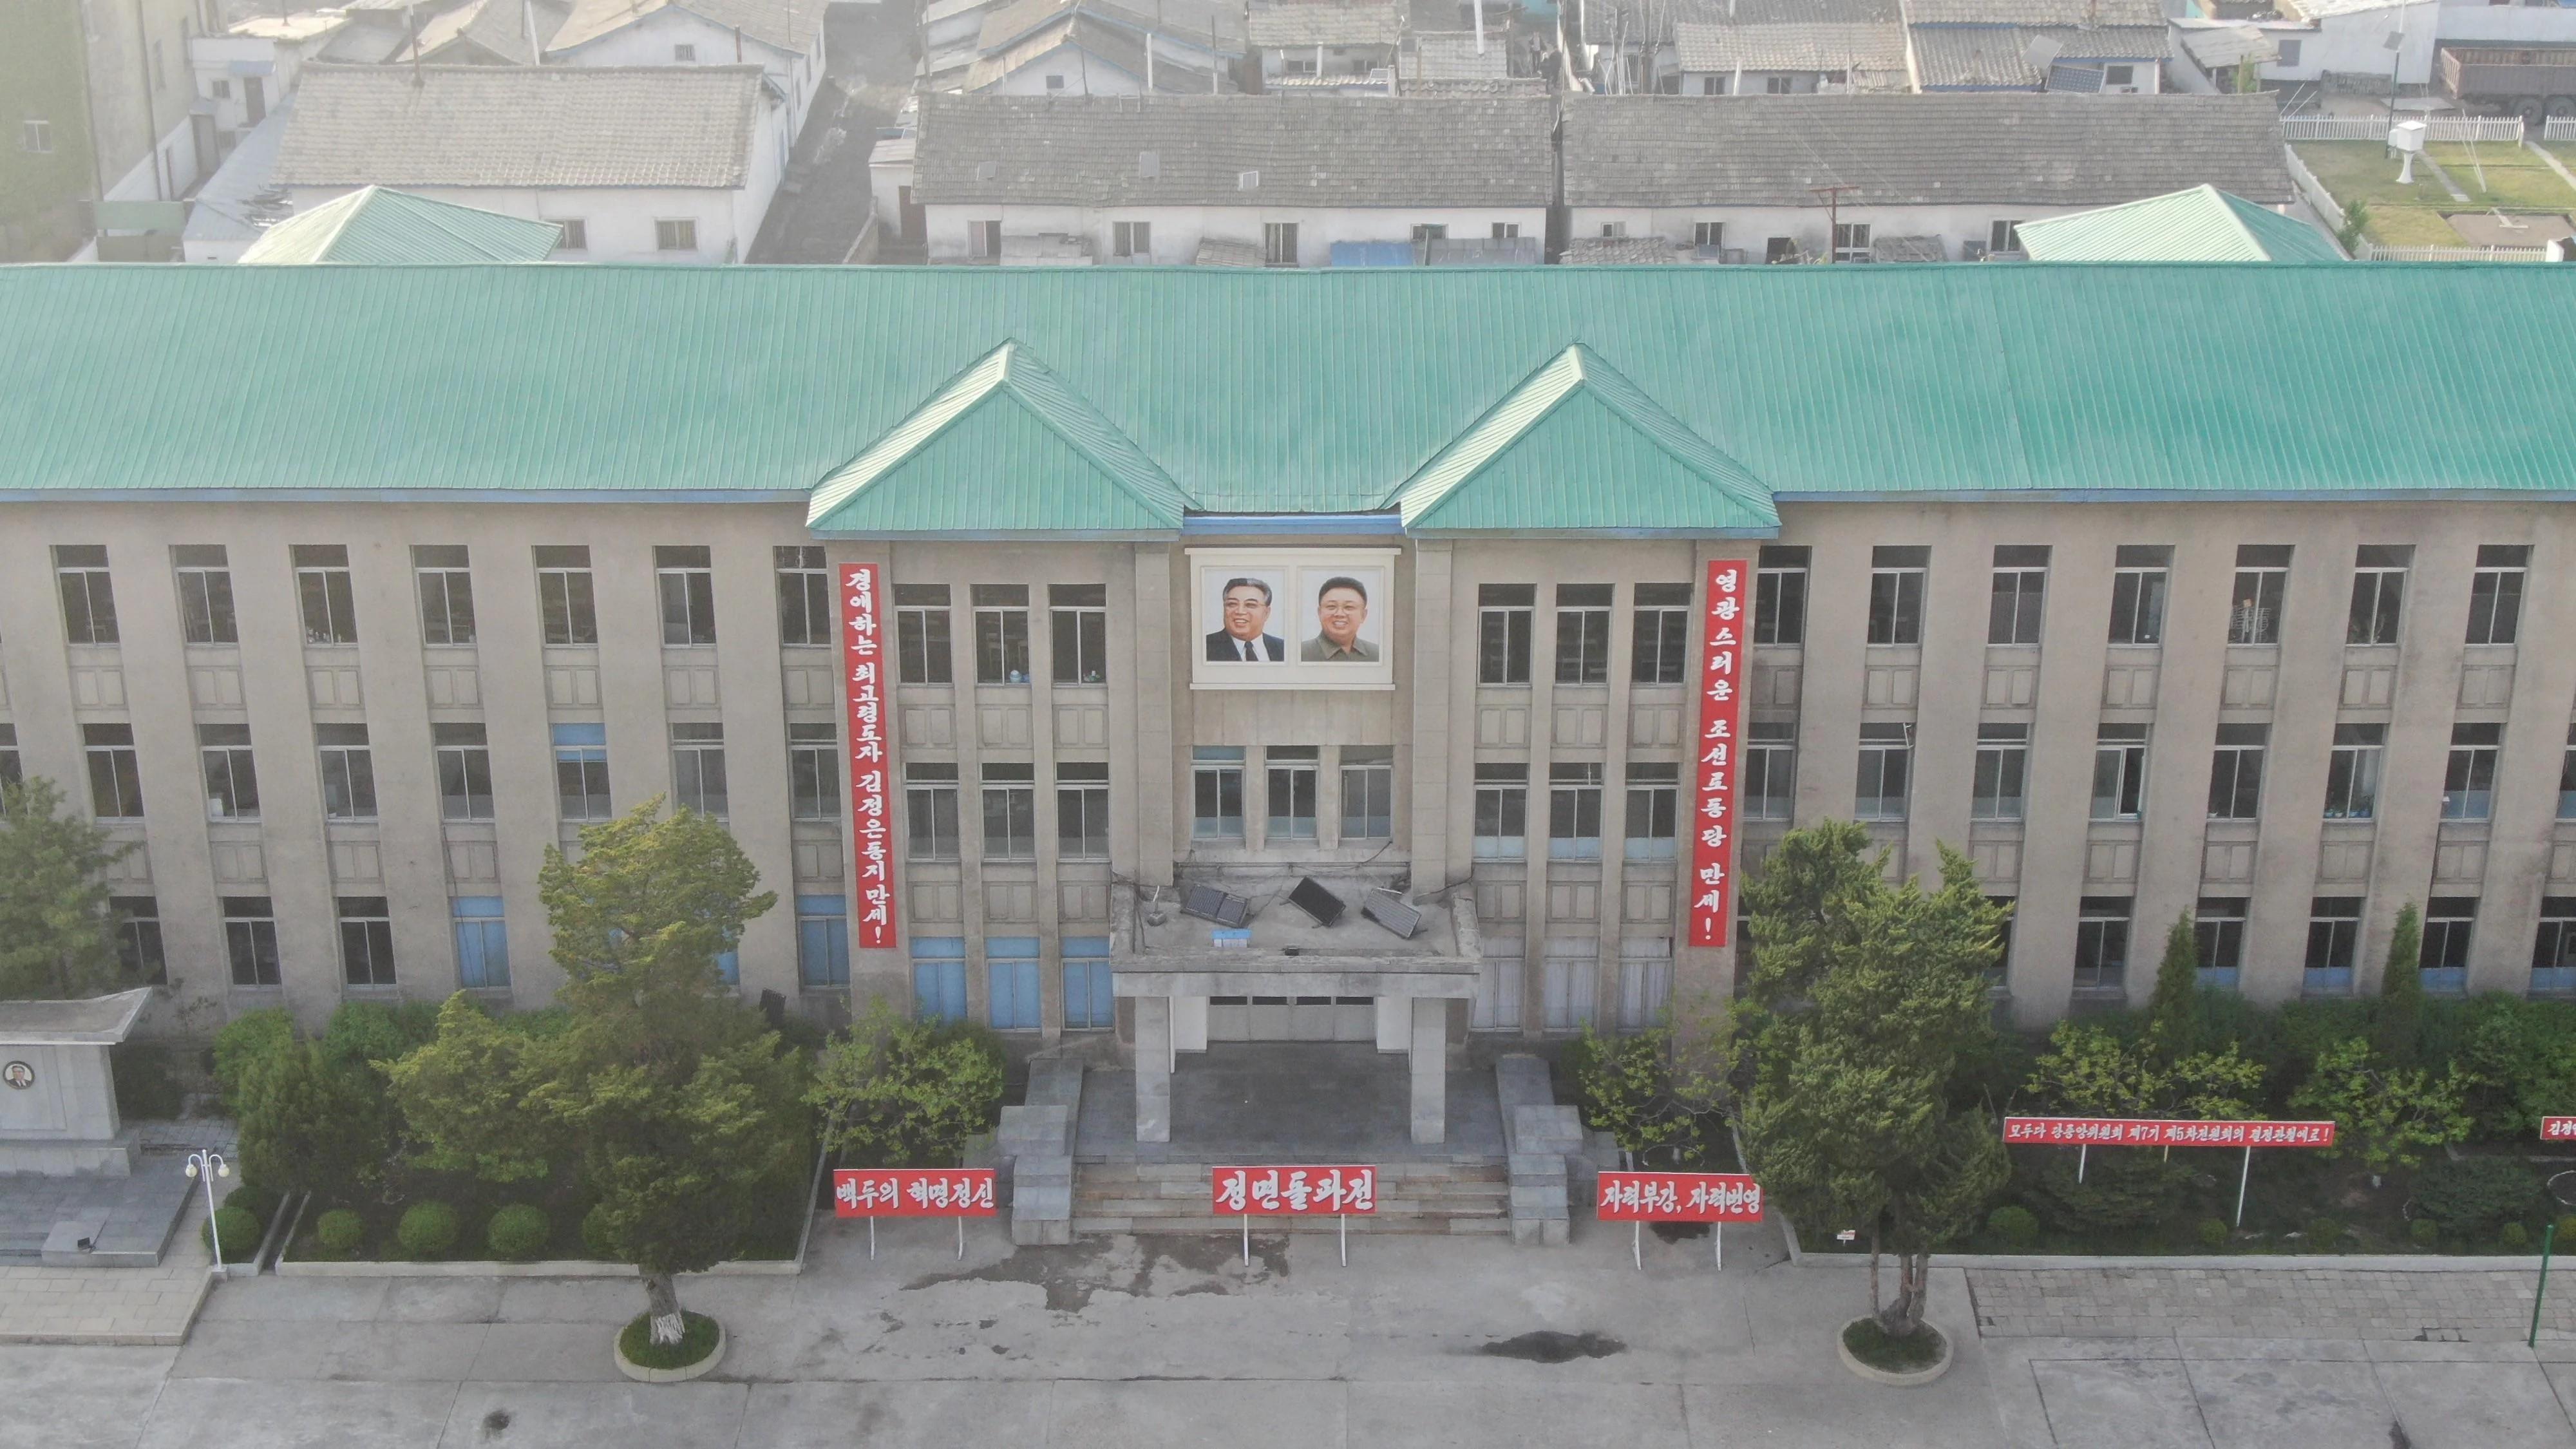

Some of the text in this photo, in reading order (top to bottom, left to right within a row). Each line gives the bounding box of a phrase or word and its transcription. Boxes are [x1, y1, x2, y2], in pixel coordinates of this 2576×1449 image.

[845, 569, 890, 944] 경애하는 최고령도자 김정은동지 만세!
[1701, 719, 1731, 848] 조선로동당
[1694, 863, 1725, 940] 만세!
[2009, 1122, 2047, 1139] 모두다
[2051, 1123, 2123, 1141] 당중앙위원회
[2128, 1124, 2159, 1141] 제7기
[2164, 1125, 2244, 1142] 제5차전원회의
[837, 1178, 994, 1209] 백두의 혁명정신
[1216, 1169, 1374, 1211] 정면돌파전
[1600, 1180, 1761, 1214] 자력부강, 자력번영
